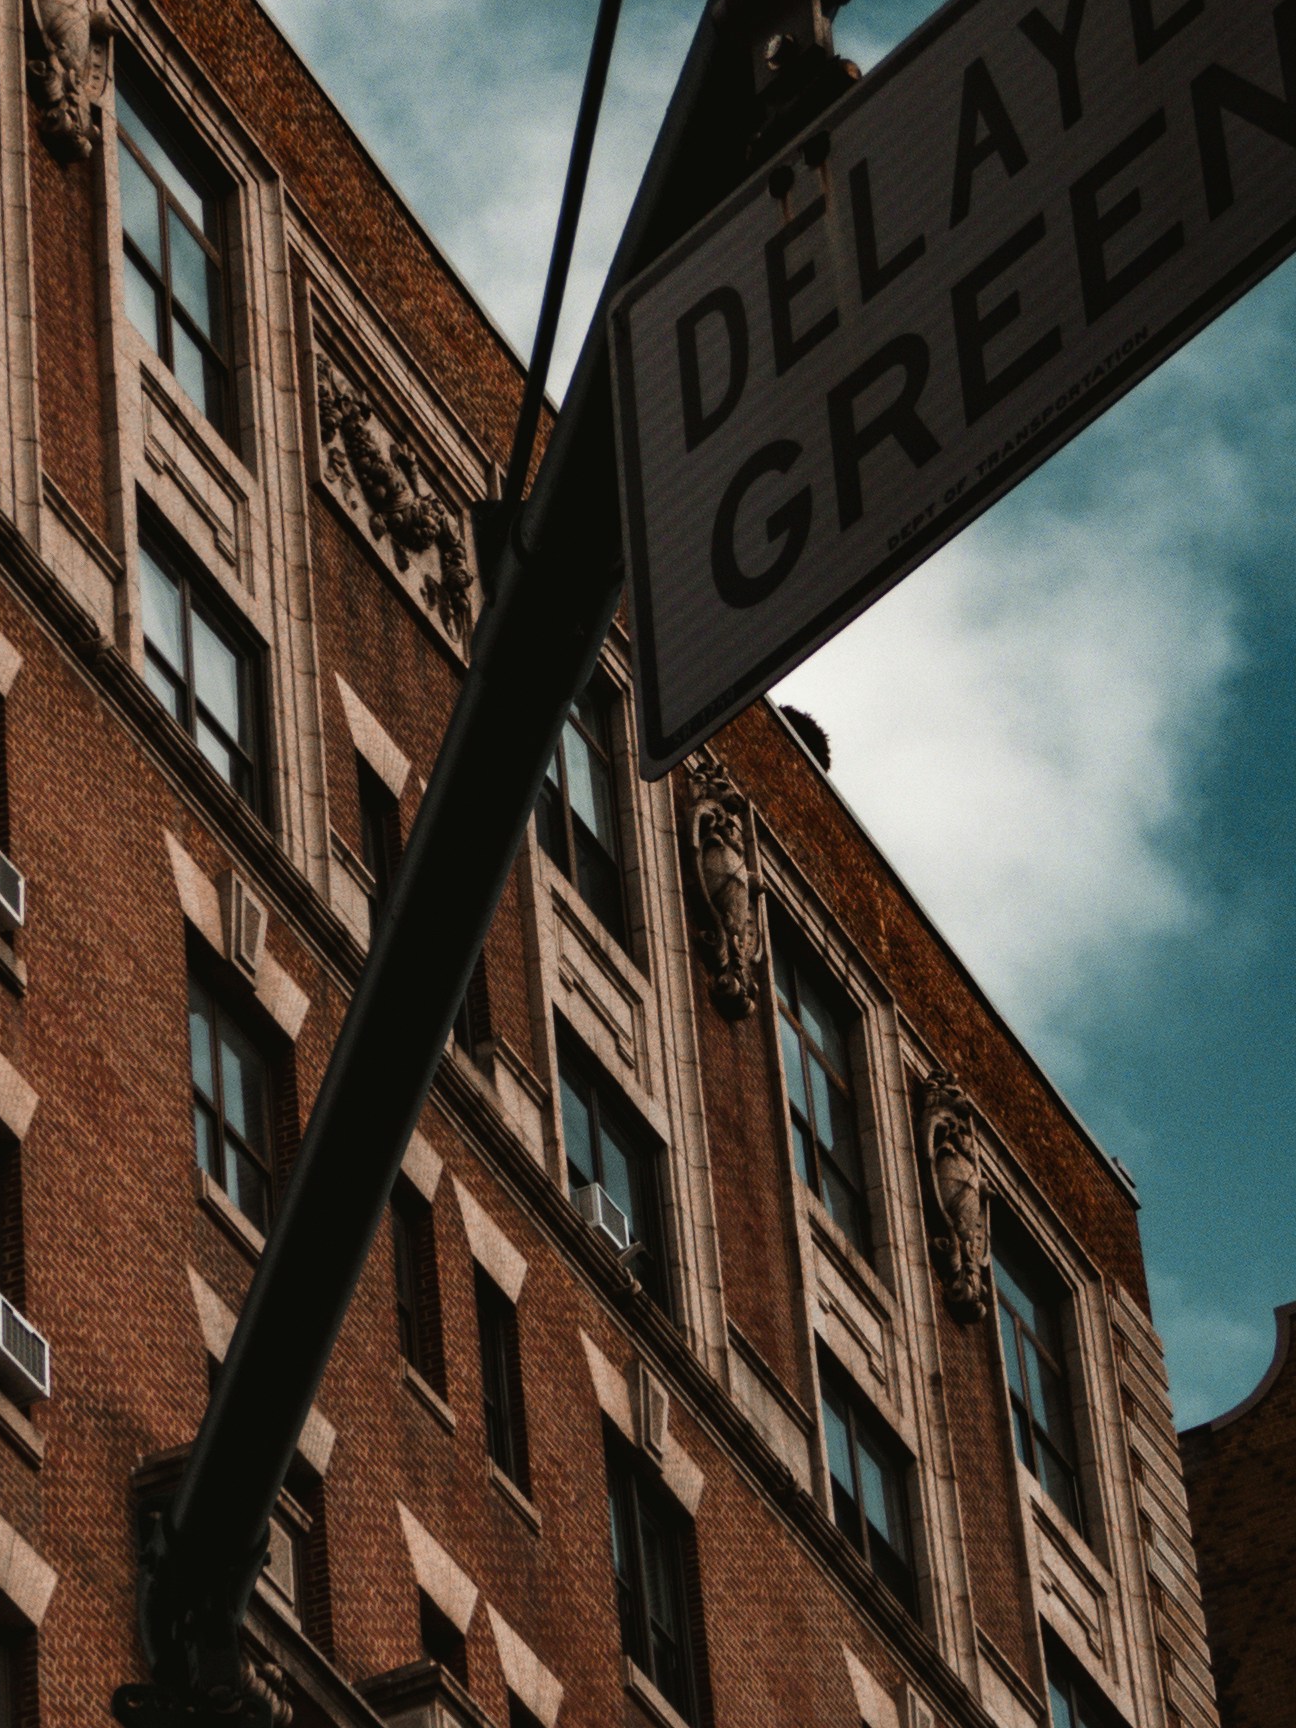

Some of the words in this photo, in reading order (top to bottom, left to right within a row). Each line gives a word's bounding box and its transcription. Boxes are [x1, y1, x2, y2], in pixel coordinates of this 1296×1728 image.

[887, 502, 936, 552] DEPT
[943, 476, 969, 506] OF
[975, 326, 1150, 476] TRANSPORTATION
